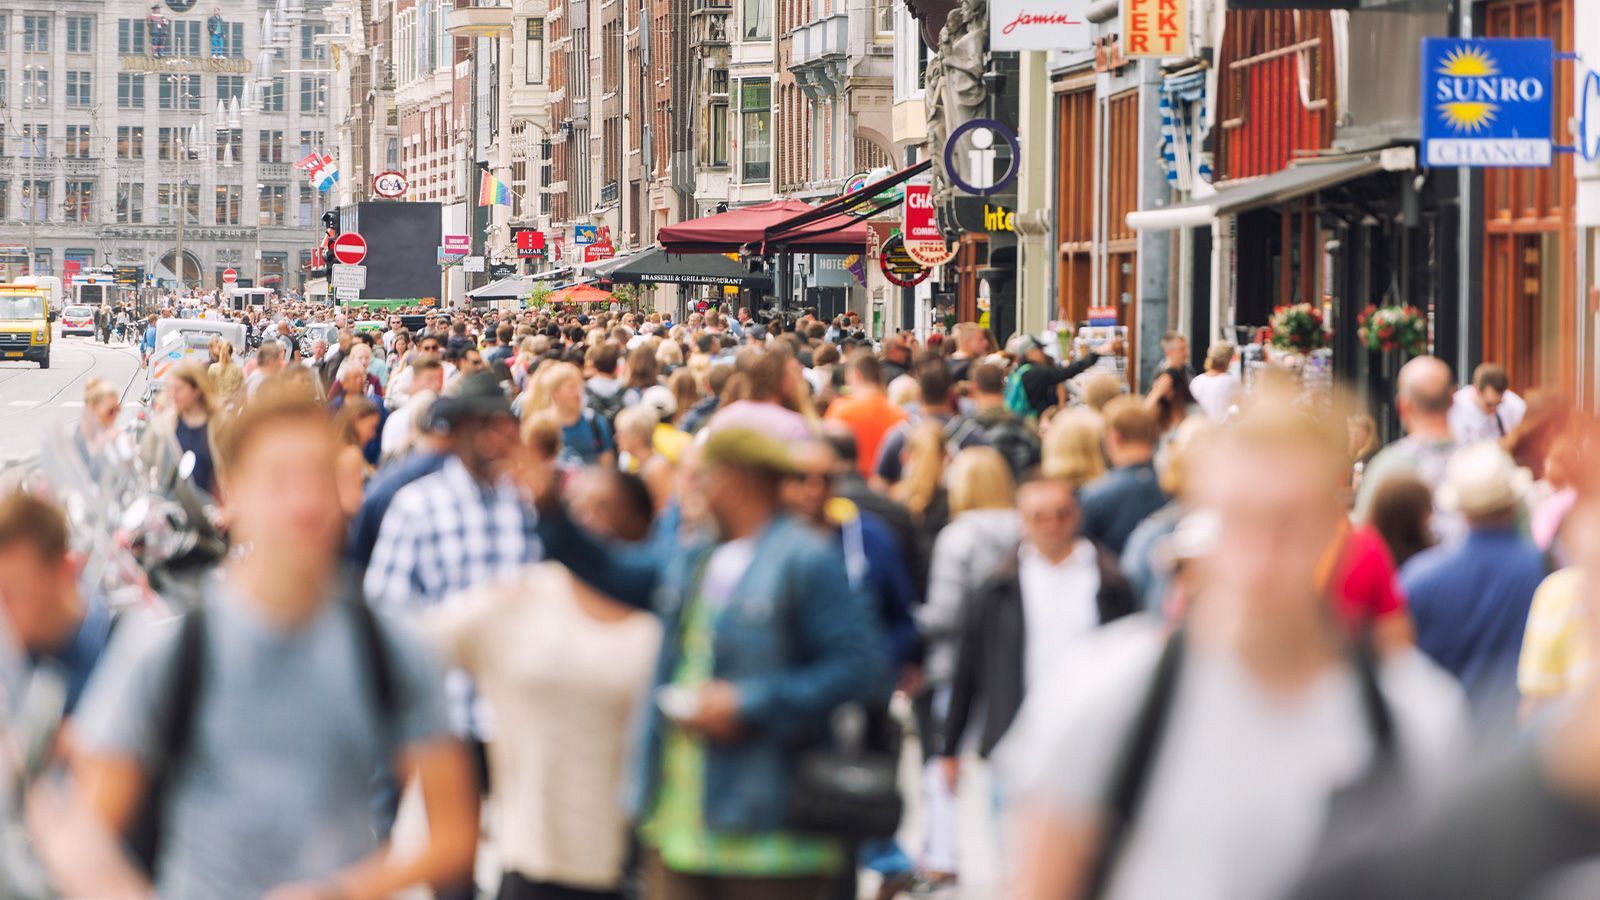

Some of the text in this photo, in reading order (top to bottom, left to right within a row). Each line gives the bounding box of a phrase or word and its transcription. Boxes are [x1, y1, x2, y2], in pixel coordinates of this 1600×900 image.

[1002, 9, 1082, 34] jamin
[1437, 77, 1544, 102] SUNRO
[1437, 142, 1539, 162] CHANGE
[379, 178, 402, 191] C&A
[702, 276, 743, 285] RESTAURANT
